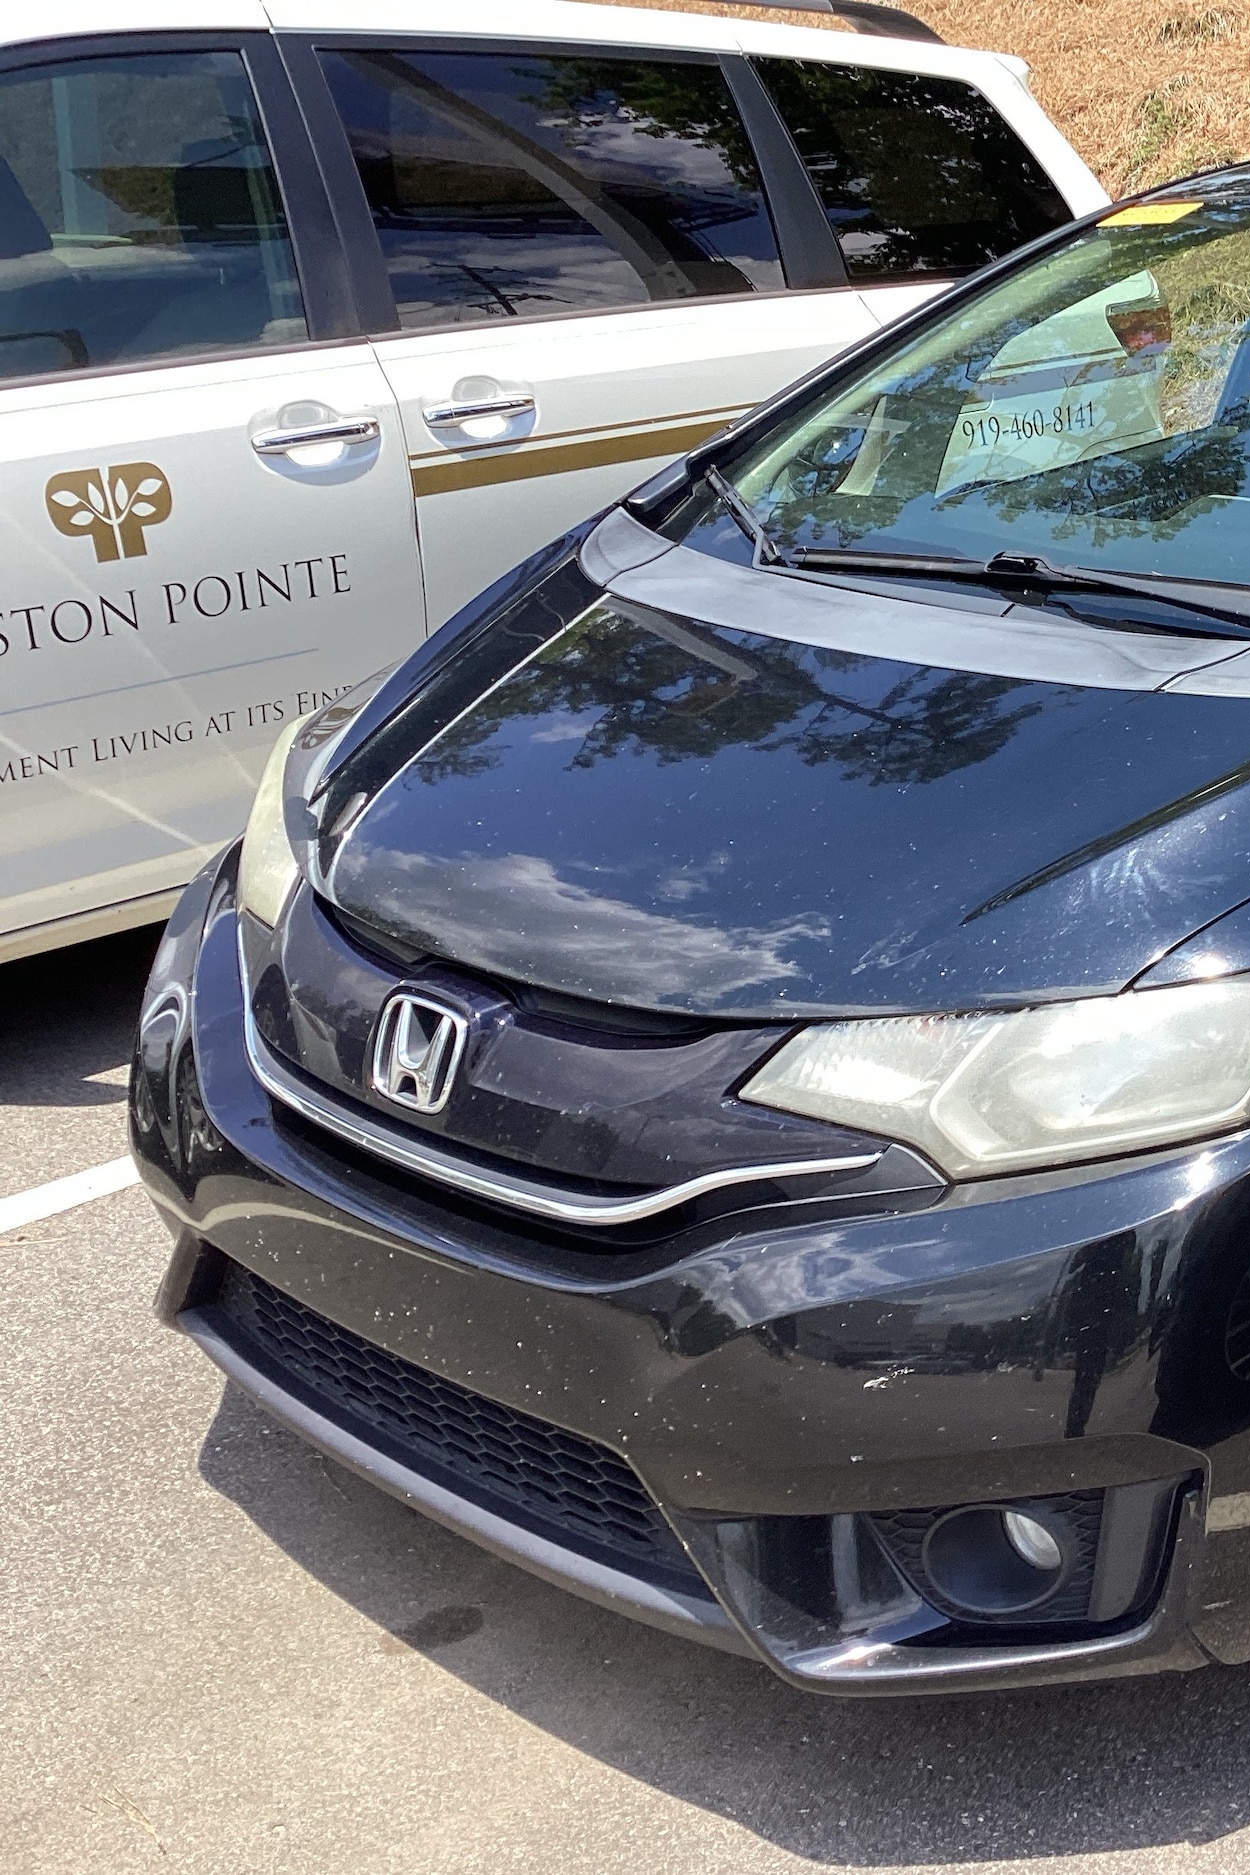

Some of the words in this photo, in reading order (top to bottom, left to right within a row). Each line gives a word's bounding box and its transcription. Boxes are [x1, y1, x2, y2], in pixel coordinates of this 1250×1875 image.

[962, 401, 1095, 449] 919-460-8141
[161, 554, 351, 625] POINTE
[91, 721, 193, 762] LIVING
[205, 711, 236, 737] AT
[248, 700, 284, 727] ITS
[296, 685, 353, 715] FIN
